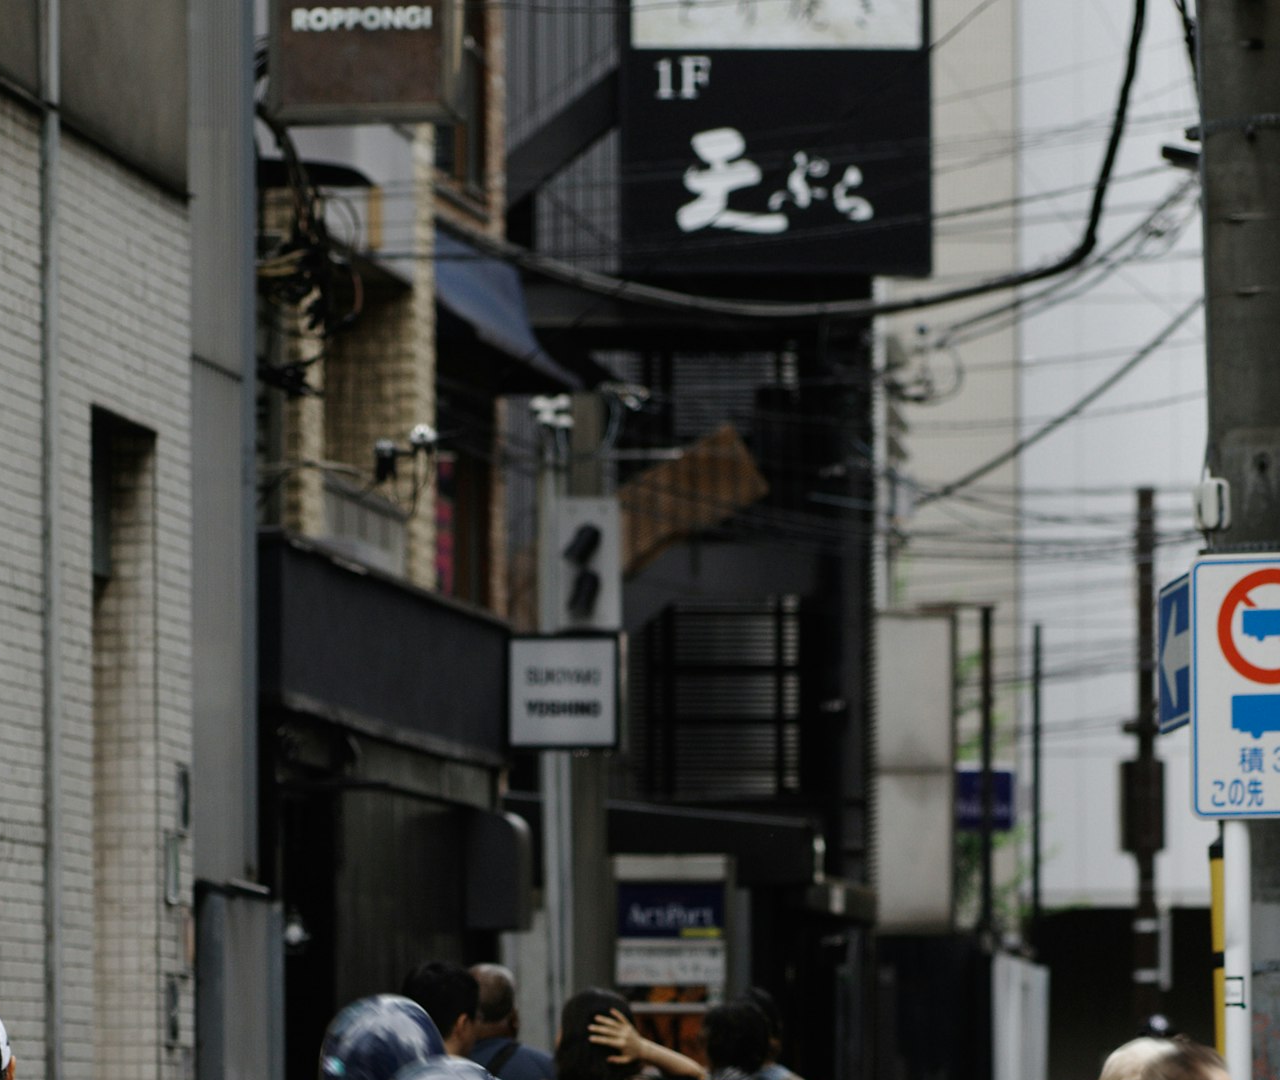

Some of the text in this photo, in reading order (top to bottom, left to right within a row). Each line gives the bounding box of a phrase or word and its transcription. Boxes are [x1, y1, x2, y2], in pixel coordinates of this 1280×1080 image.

[291, 5, 433, 32] ROPPONGI
[656, 55, 711, 99] 1F
[1211, 778, 1264, 807] この先
